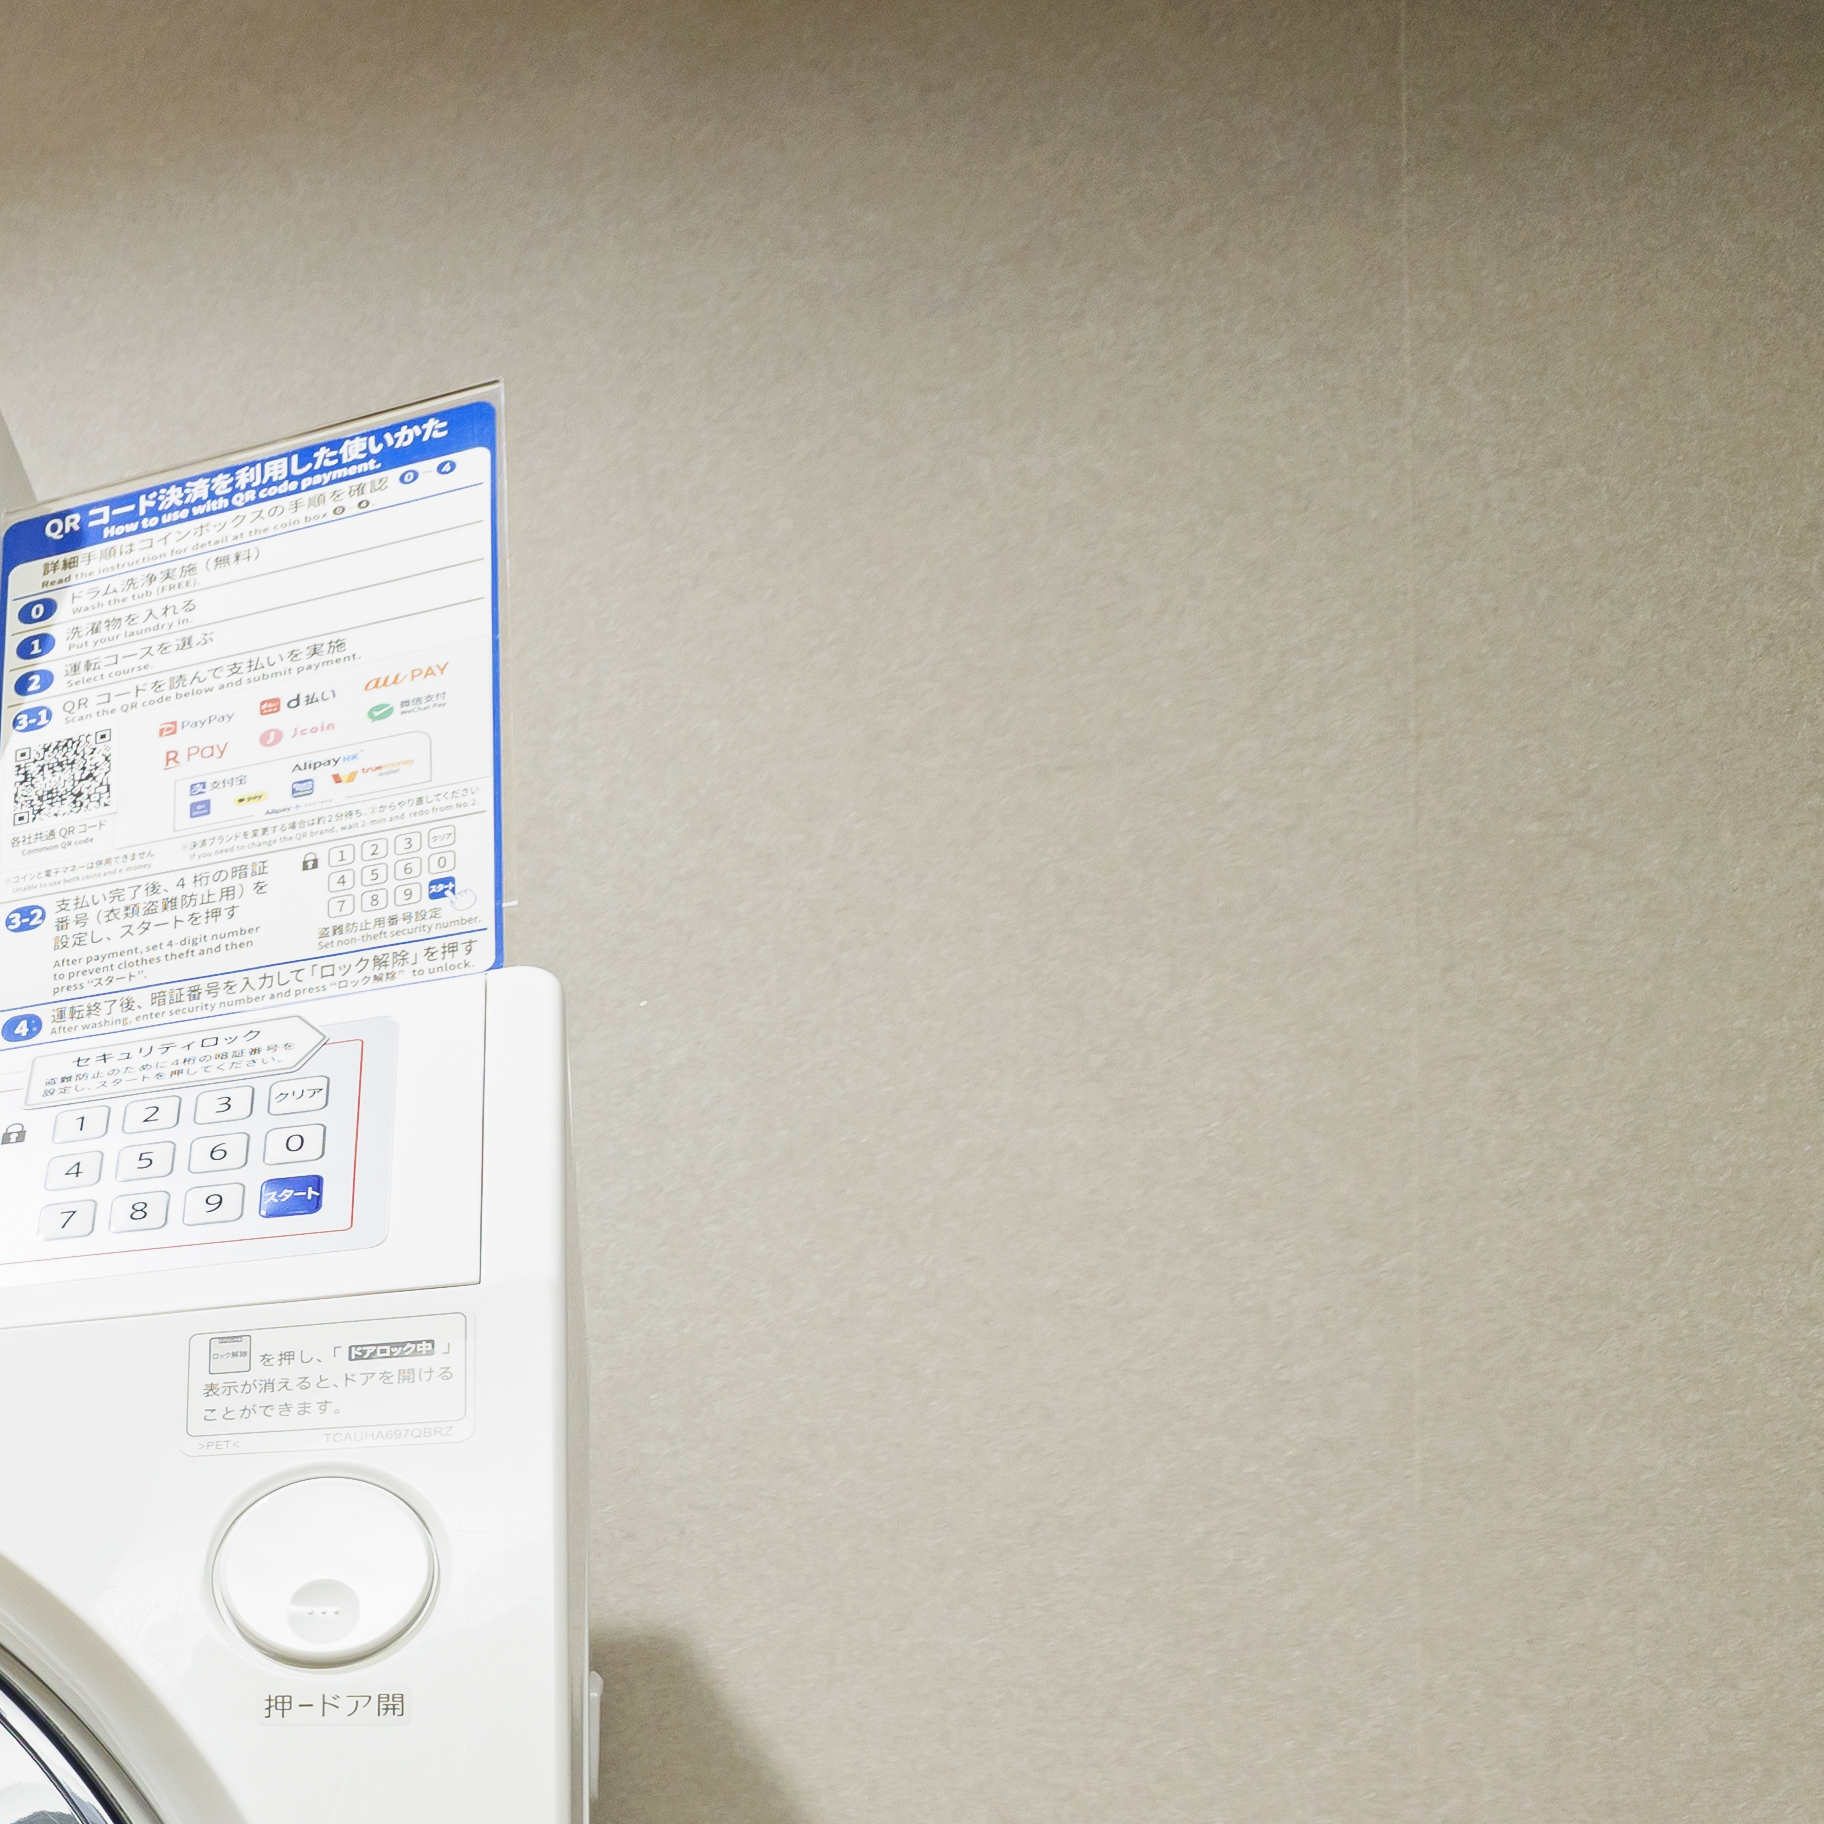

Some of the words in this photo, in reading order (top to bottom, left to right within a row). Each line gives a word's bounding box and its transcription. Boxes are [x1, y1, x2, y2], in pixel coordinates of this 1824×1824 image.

[45, 514, 80, 540] QR
[88, 417, 448, 527] コード決済を利用した使いかた
[103, 524, 139, 539] How
[141, 518, 158, 528] to
[161, 511, 190, 524] use
[192, 499, 229, 516] with
[232, 488, 253, 508] QR
[259, 480, 298, 500] code
[301, 461, 381, 493] payment.
[72, 600, 105, 614] Wash
[108, 593, 127, 607] the
[132, 587, 151, 602] tub
[31, 603, 43, 620] 0
[66, 600, 197, 640] 洗濯物を入れる
[64, 632, 214, 677] 運転コースを選ぶ
[67, 673, 104, 687] Select
[109, 664, 154, 679] course.
[410, 662, 450, 682] PAY
[27, 677, 40, 691] 2
[63, 697, 89, 714] QR
[15, 710, 50, 729] 3-1
[181, 712, 235, 730] PayPay
[8, 909, 43, 929] 3-2
[318, 940, 335, 950] Set
[337, 930, 387, 946] non-theft
[390, 924, 432, 940] security
[435, 915, 482, 931] number.
[53, 957, 83, 969] After
[87, 946, 143, 965] payment,
[146, 941, 163, 952] set
[167, 933, 207, 950] 4-digit
[211, 926, 260, 942] number
[274, 1086, 325, 1103] クリア
[143, 1105, 161, 1123] 2
[215, 1096, 233, 1113] 3
[76, 1115, 86, 1132] 1
[210, 1142, 228, 1161] 6
[285, 1133, 304, 1152] 0
[64, 1161, 84, 1179] 4
[137, 1151, 155, 1170] 5
[205, 1193, 224, 1213] 9
[263, 1185, 321, 1204] スタート
[59, 1209, 77, 1230] 7
[130, 1201, 149, 1221] 8
[203, 1400, 343, 1423] ことができます。
